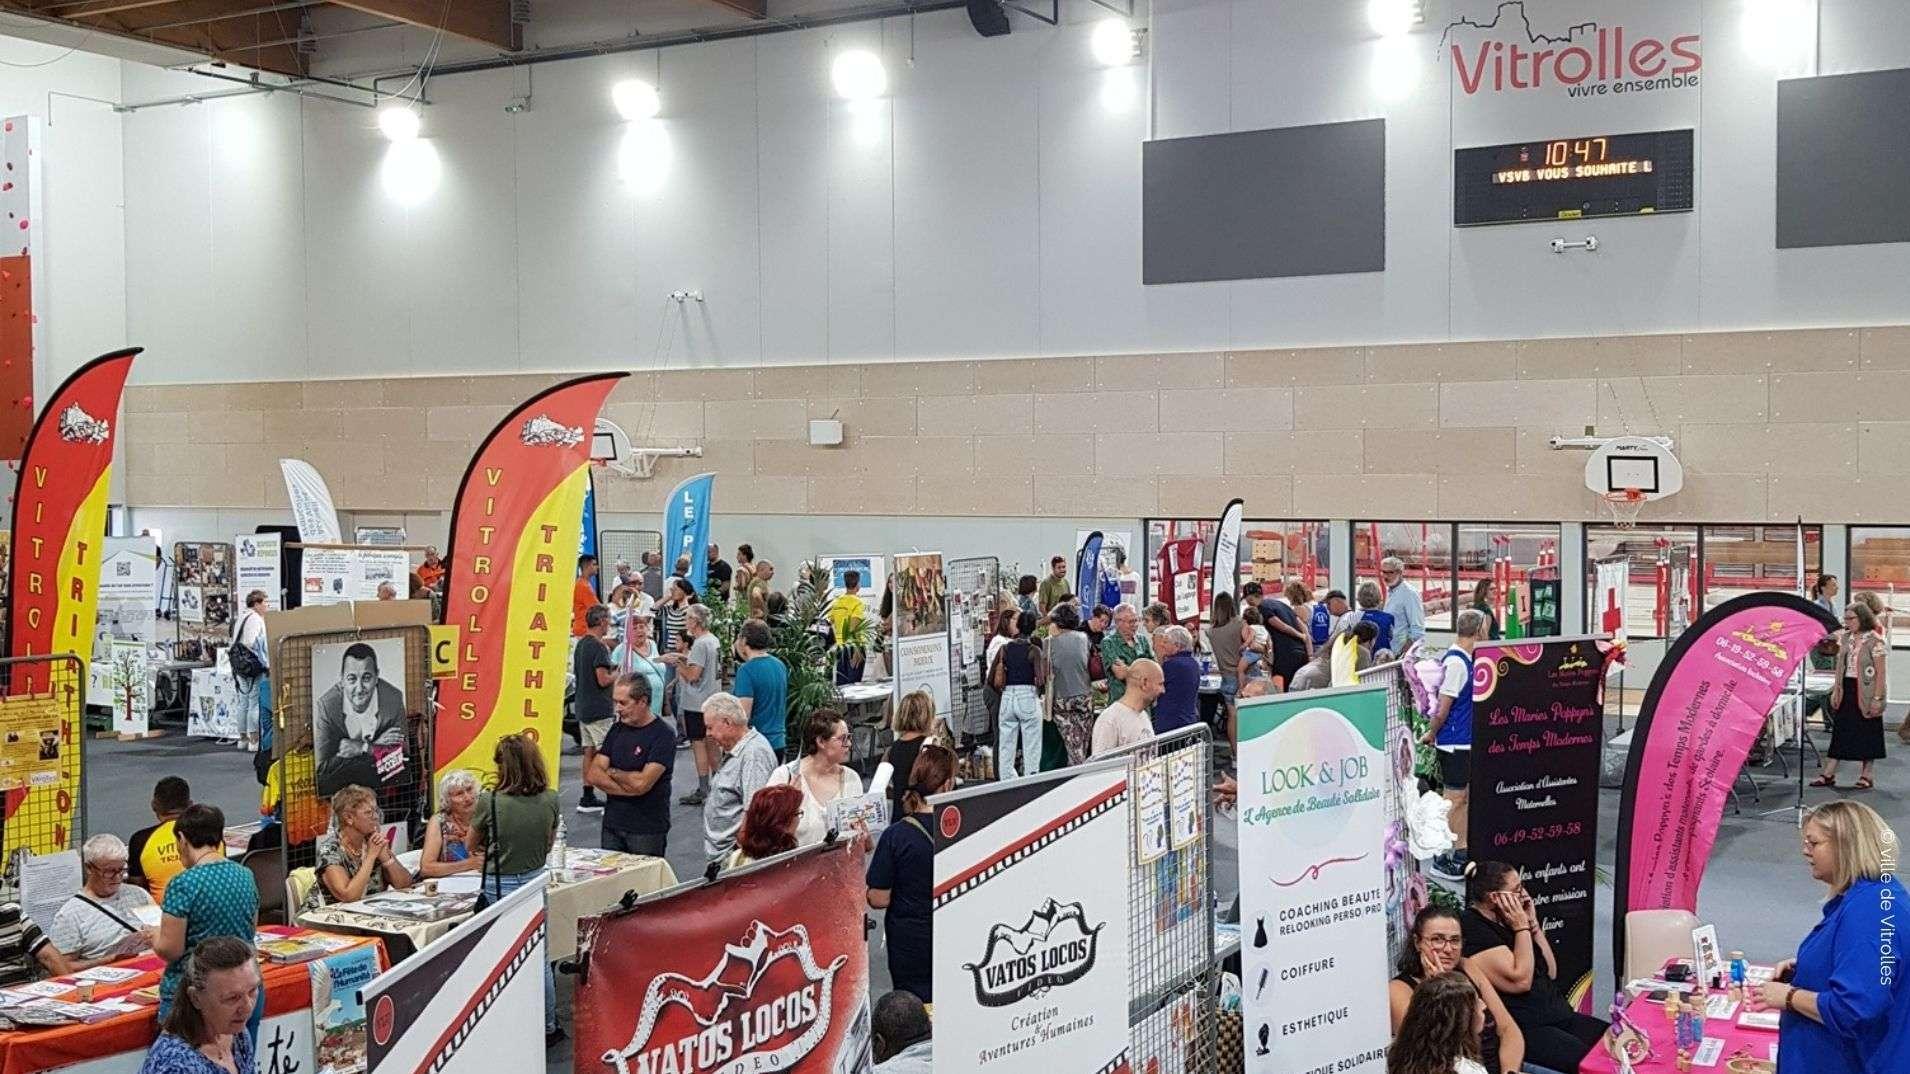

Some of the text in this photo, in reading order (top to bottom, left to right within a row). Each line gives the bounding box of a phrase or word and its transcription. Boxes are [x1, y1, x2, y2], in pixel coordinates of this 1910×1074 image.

[1451, 27, 1701, 95] Vitrolles
[1568, 73, 1699, 98] vivre ensemble
[1545, 139, 1606, 165] 10:47
[1498, 170, 1530, 184] VSVB
[1536, 167, 1569, 180] VOUS
[1575, 161, 1637, 178] SOUHAITE
[459, 467, 503, 720] VITROLLES
[523, 524, 558, 745] TRIATHLO
[436, 640, 450, 664] C
[1489, 708, 1509, 726] Les
[1511, 705, 1548, 723] Maries
[1677, 680, 1710, 734] Modernes
[1488, 730, 1593, 754] des Temps Modernes
[1667, 735, 1690, 769] Temps
[1261, 755, 1369, 795] LOOK & JOB
[1496, 781, 1535, 794] Association
[1243, 801, 1293, 826] L'Agence
[1292, 799, 1305, 815] de
[1306, 792, 1341, 812] Beauté
[1343, 785, 1380, 805] Solidaire
[1494, 821, 1582, 846] 06-19-52-59-58
[1534, 862, 1567, 883] enfants
[1569, 860, 1586, 873] ont
[1279, 888, 1381, 922] COACHING BEAUTE
[1552, 887, 1587, 903] mission
[1279, 902, 1383, 936] RELOOKING PERSO PRO
[986, 938, 1087, 989] VATOS LOCOS
[1280, 957, 1336, 982] COIFFURE
[638, 986, 818, 1074] VATOS LOCOS
[1011, 1005, 1059, 1031] Création
[1282, 1006, 1349, 1037] ESTHETIQUE
[978, 1014, 1094, 1065] Aventures Humaines
